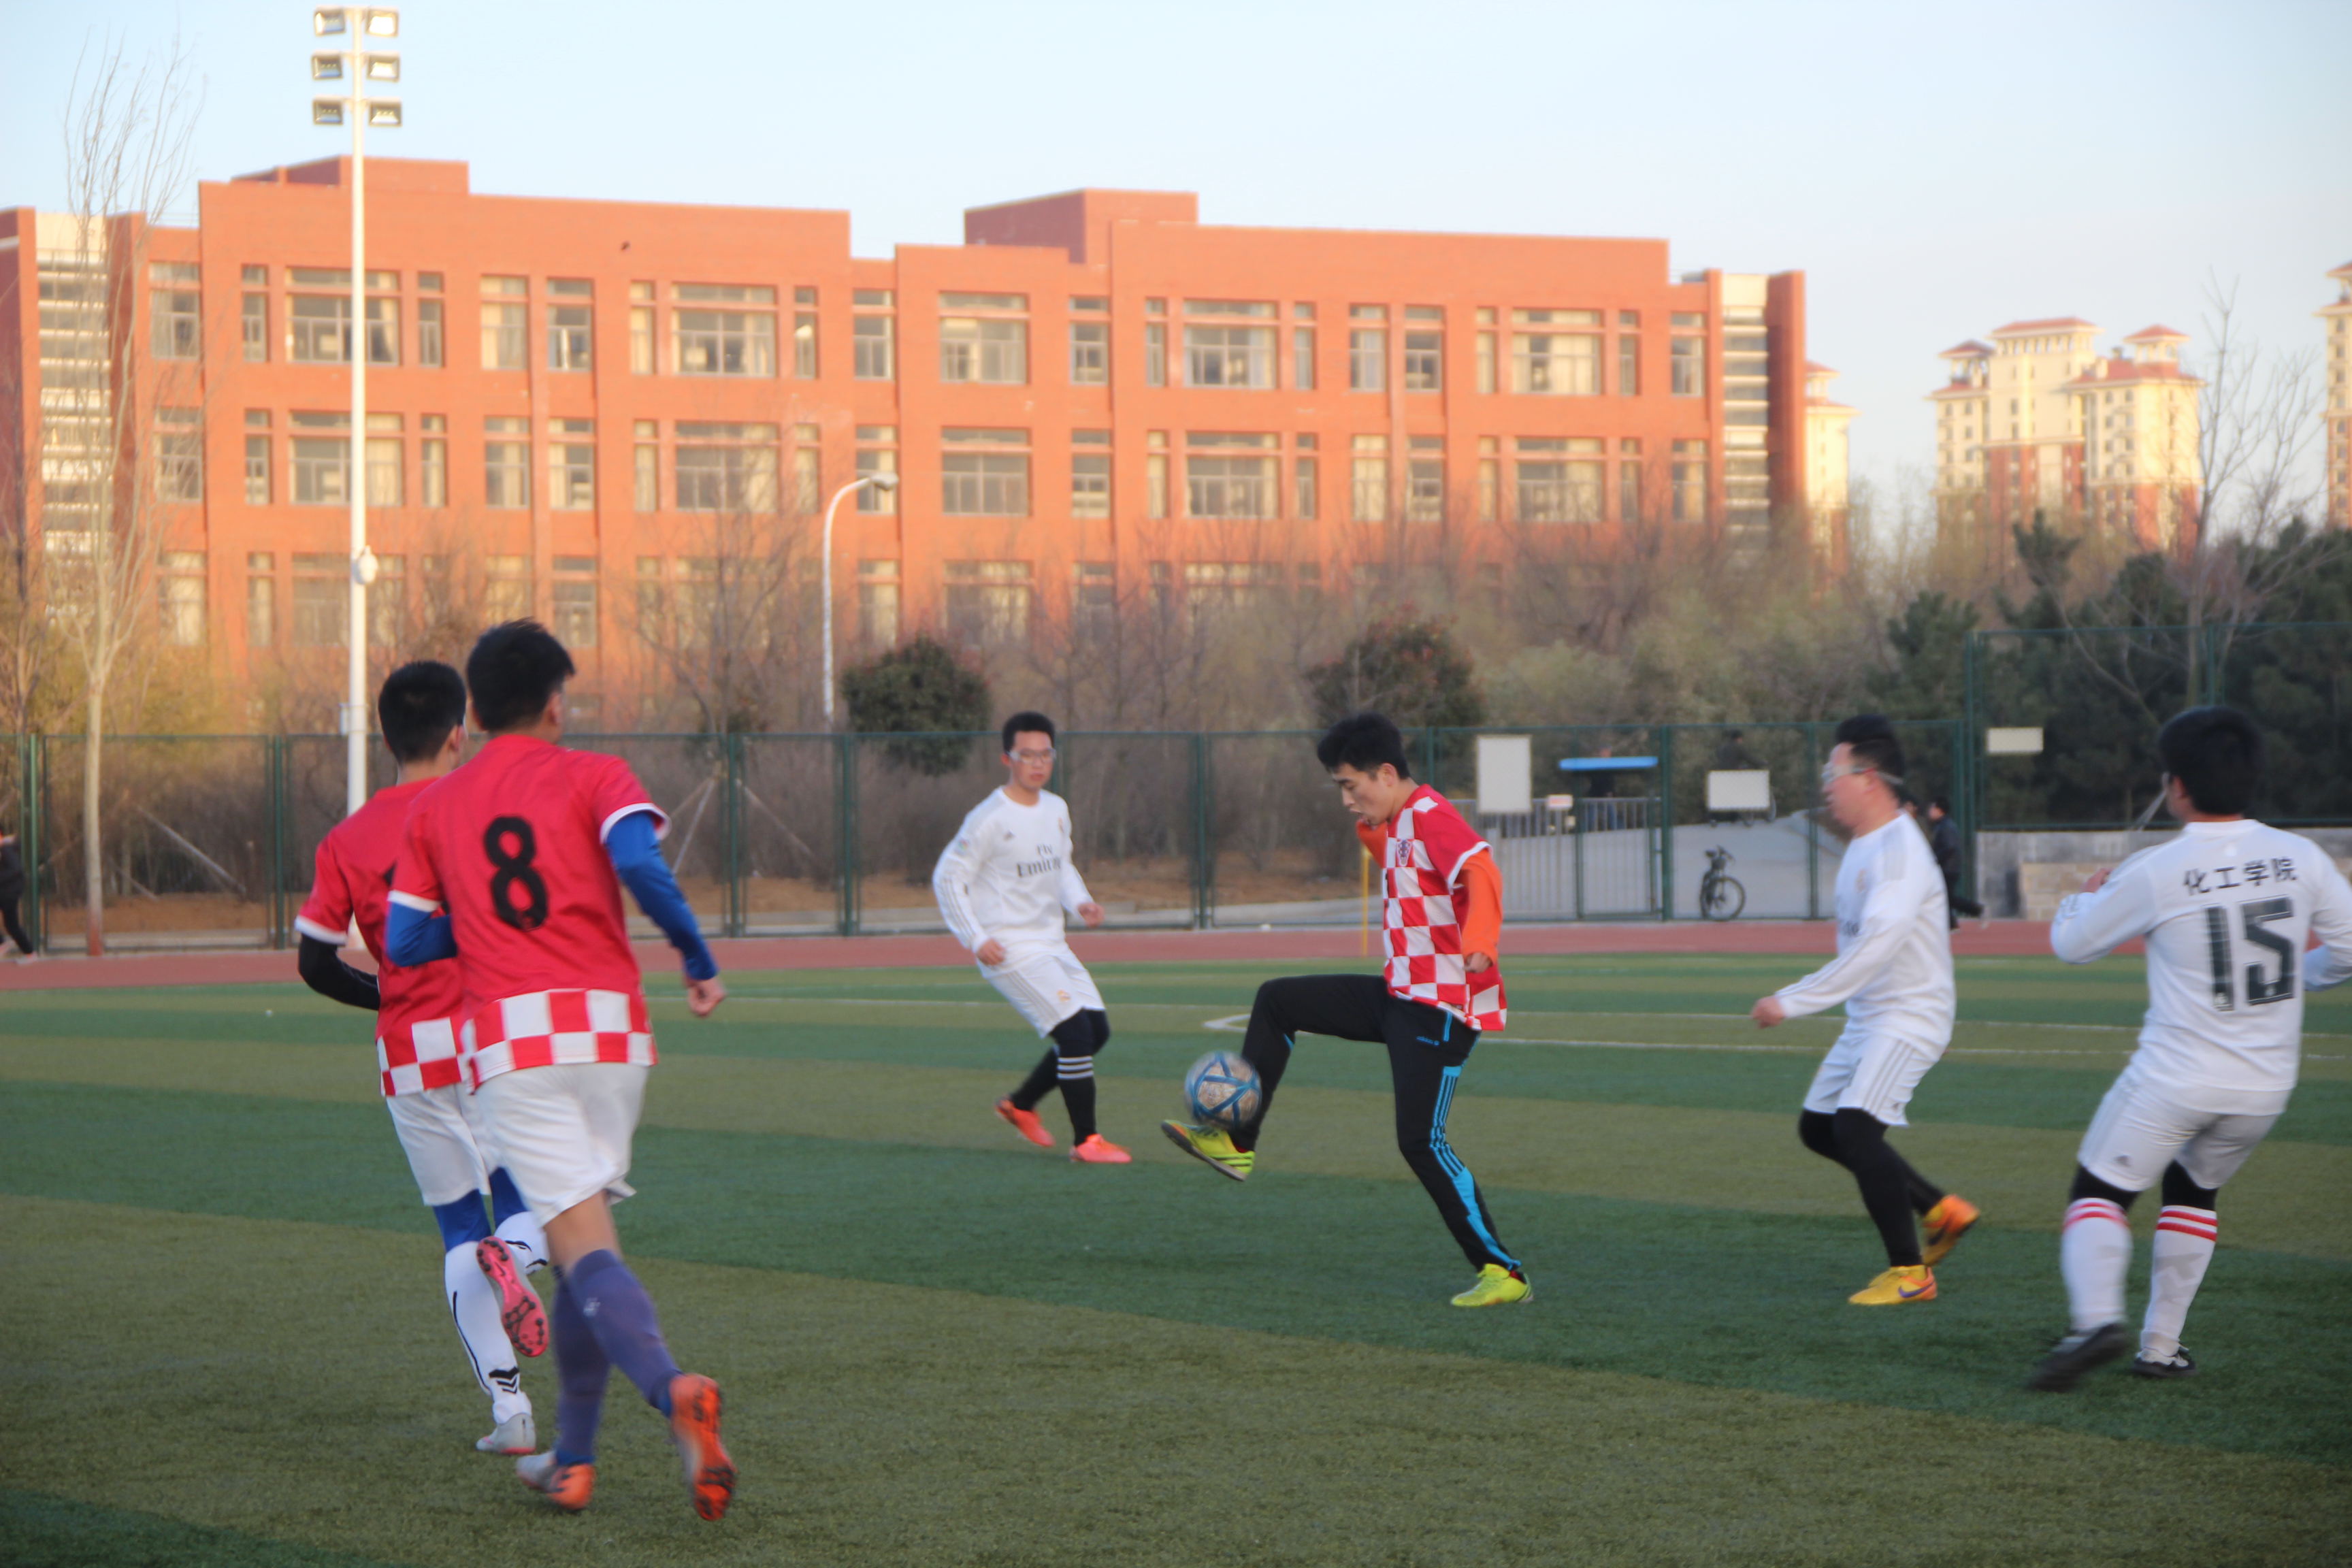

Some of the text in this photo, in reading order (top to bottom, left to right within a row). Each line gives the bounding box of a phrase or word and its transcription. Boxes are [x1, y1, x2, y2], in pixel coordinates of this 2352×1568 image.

[484, 814, 549, 931] 8
[2183, 856, 2299, 896] 化工学院
[2205, 895, 2296, 1012] 15
